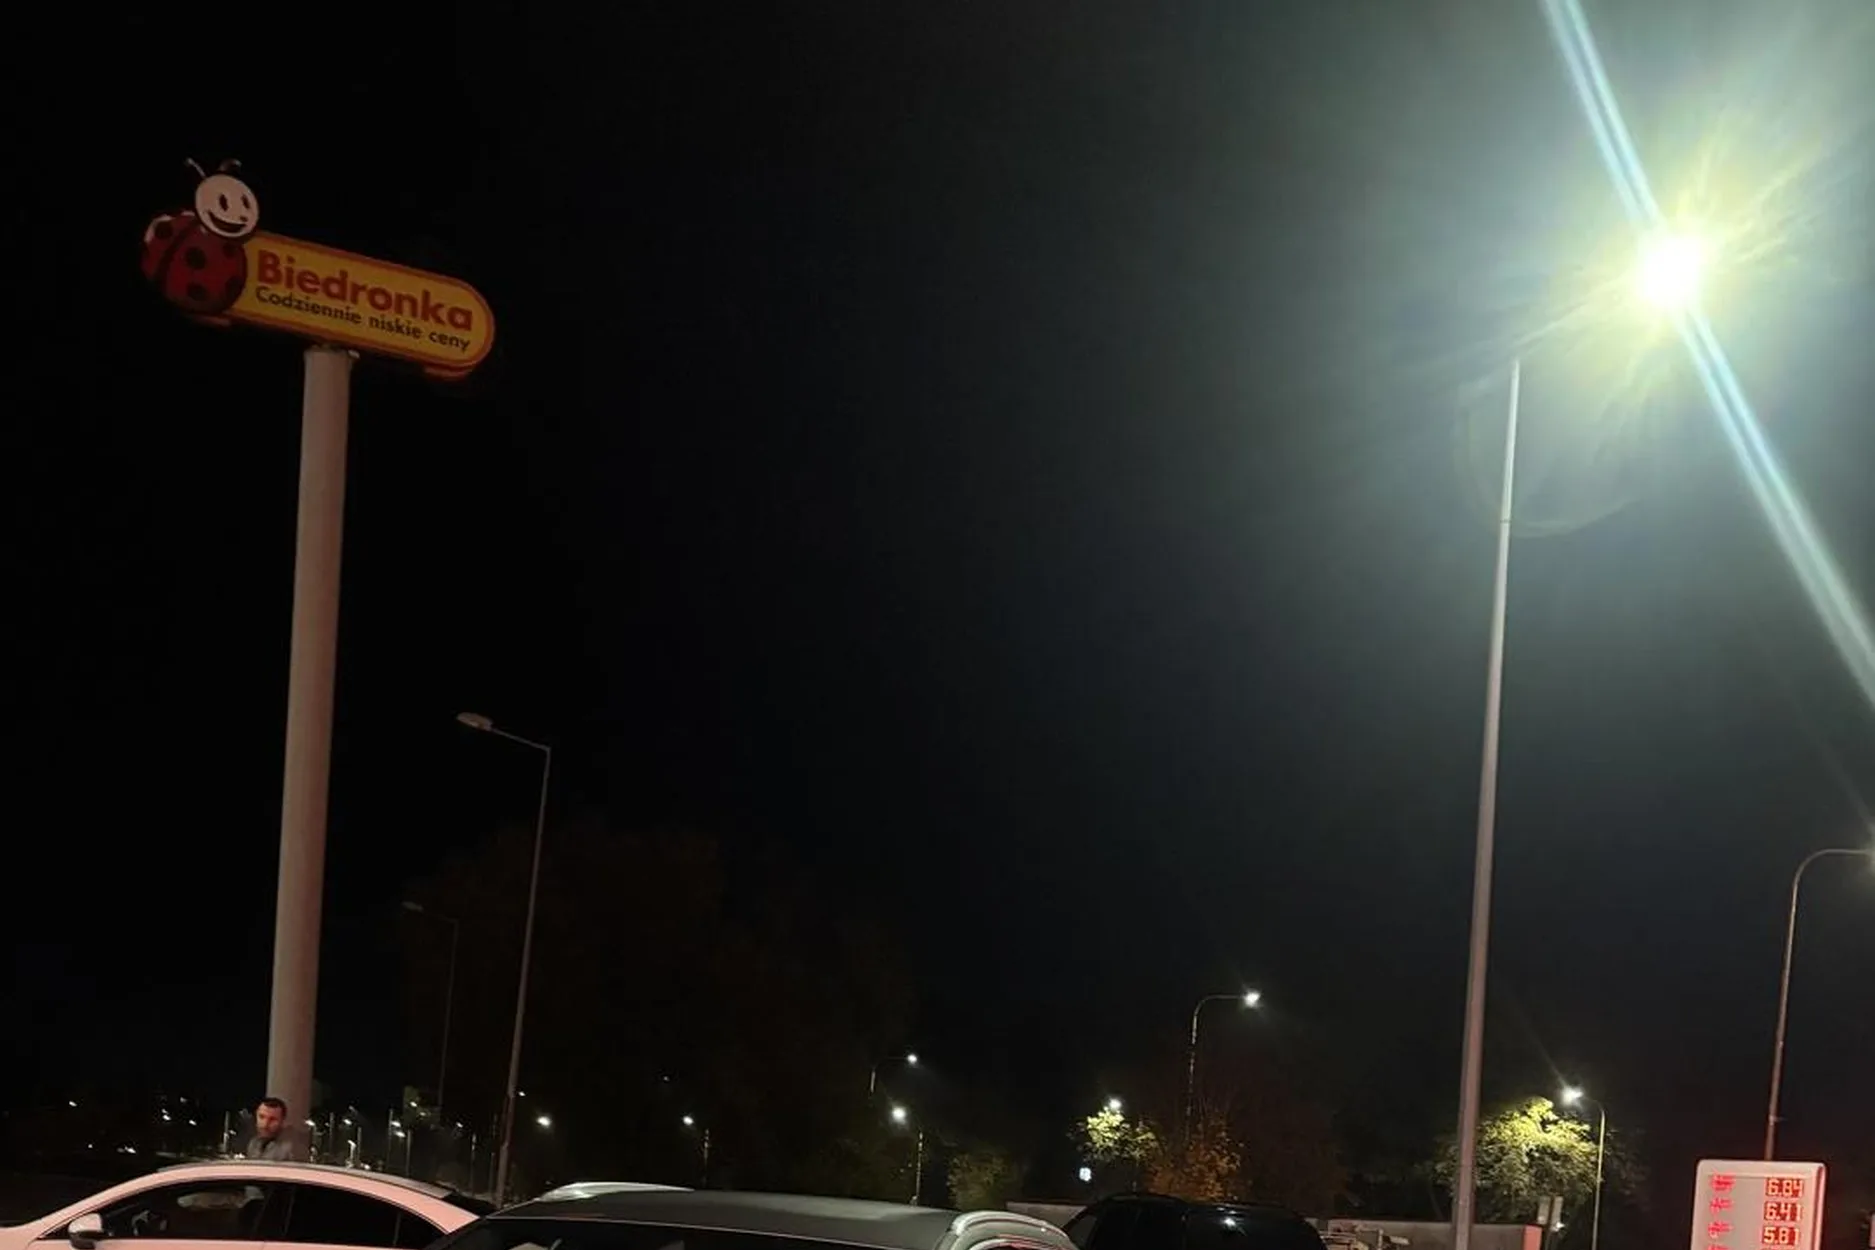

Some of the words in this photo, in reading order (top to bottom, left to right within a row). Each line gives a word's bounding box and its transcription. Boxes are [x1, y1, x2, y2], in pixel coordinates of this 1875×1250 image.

[257, 250, 474, 331] Biedronka
[256, 286, 362, 325] Codziennie
[368, 314, 422, 340] niskie
[429, 331, 471, 353] ceny
[1767, 1178, 1803, 1197] 6.84
[1765, 1202, 1801, 1221] 6.41
[1763, 1227, 1799, 1245] 5.81
